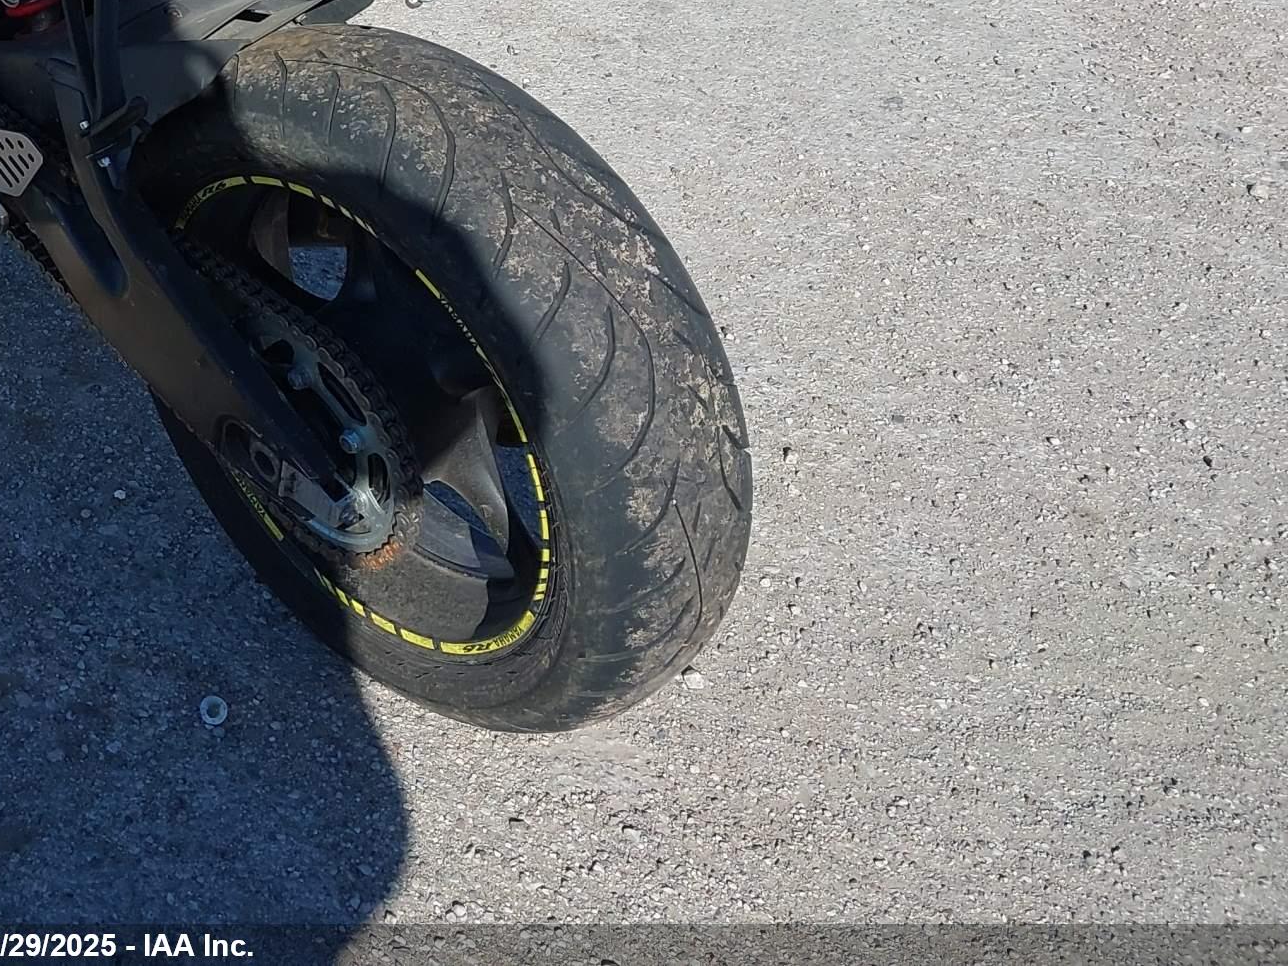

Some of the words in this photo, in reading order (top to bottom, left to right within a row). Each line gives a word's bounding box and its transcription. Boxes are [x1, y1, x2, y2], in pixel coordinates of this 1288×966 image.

[200, 181, 227, 198] R6
[492, 625, 524, 647] YAMAHA
[462, 642, 493, 654] R6
